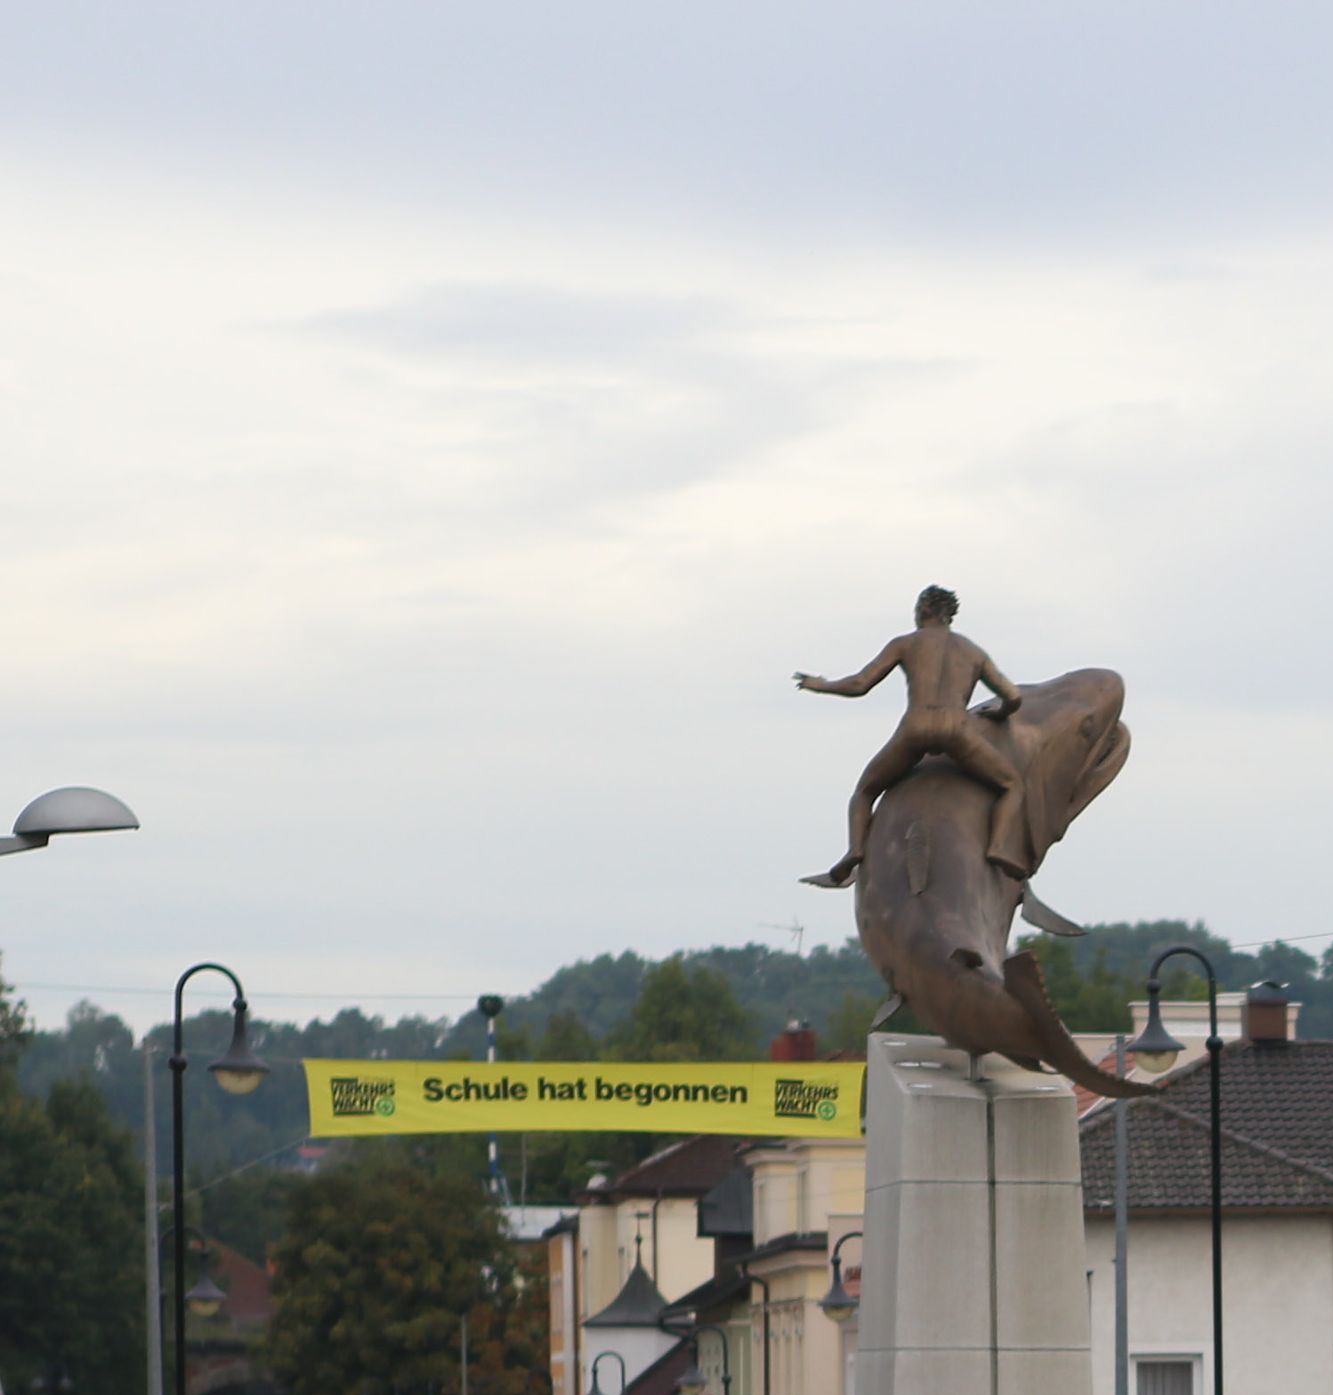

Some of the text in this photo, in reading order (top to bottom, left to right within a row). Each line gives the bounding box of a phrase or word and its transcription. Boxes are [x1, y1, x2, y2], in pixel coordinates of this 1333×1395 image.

[333, 1081, 395, 1097] VERKEHRS
[423, 1076, 748, 1107] Schule hat begonnen
[776, 1084, 839, 1101] VERKEHRS
[334, 1097, 376, 1112] WACHT
[776, 1100, 818, 1113] WACHT
